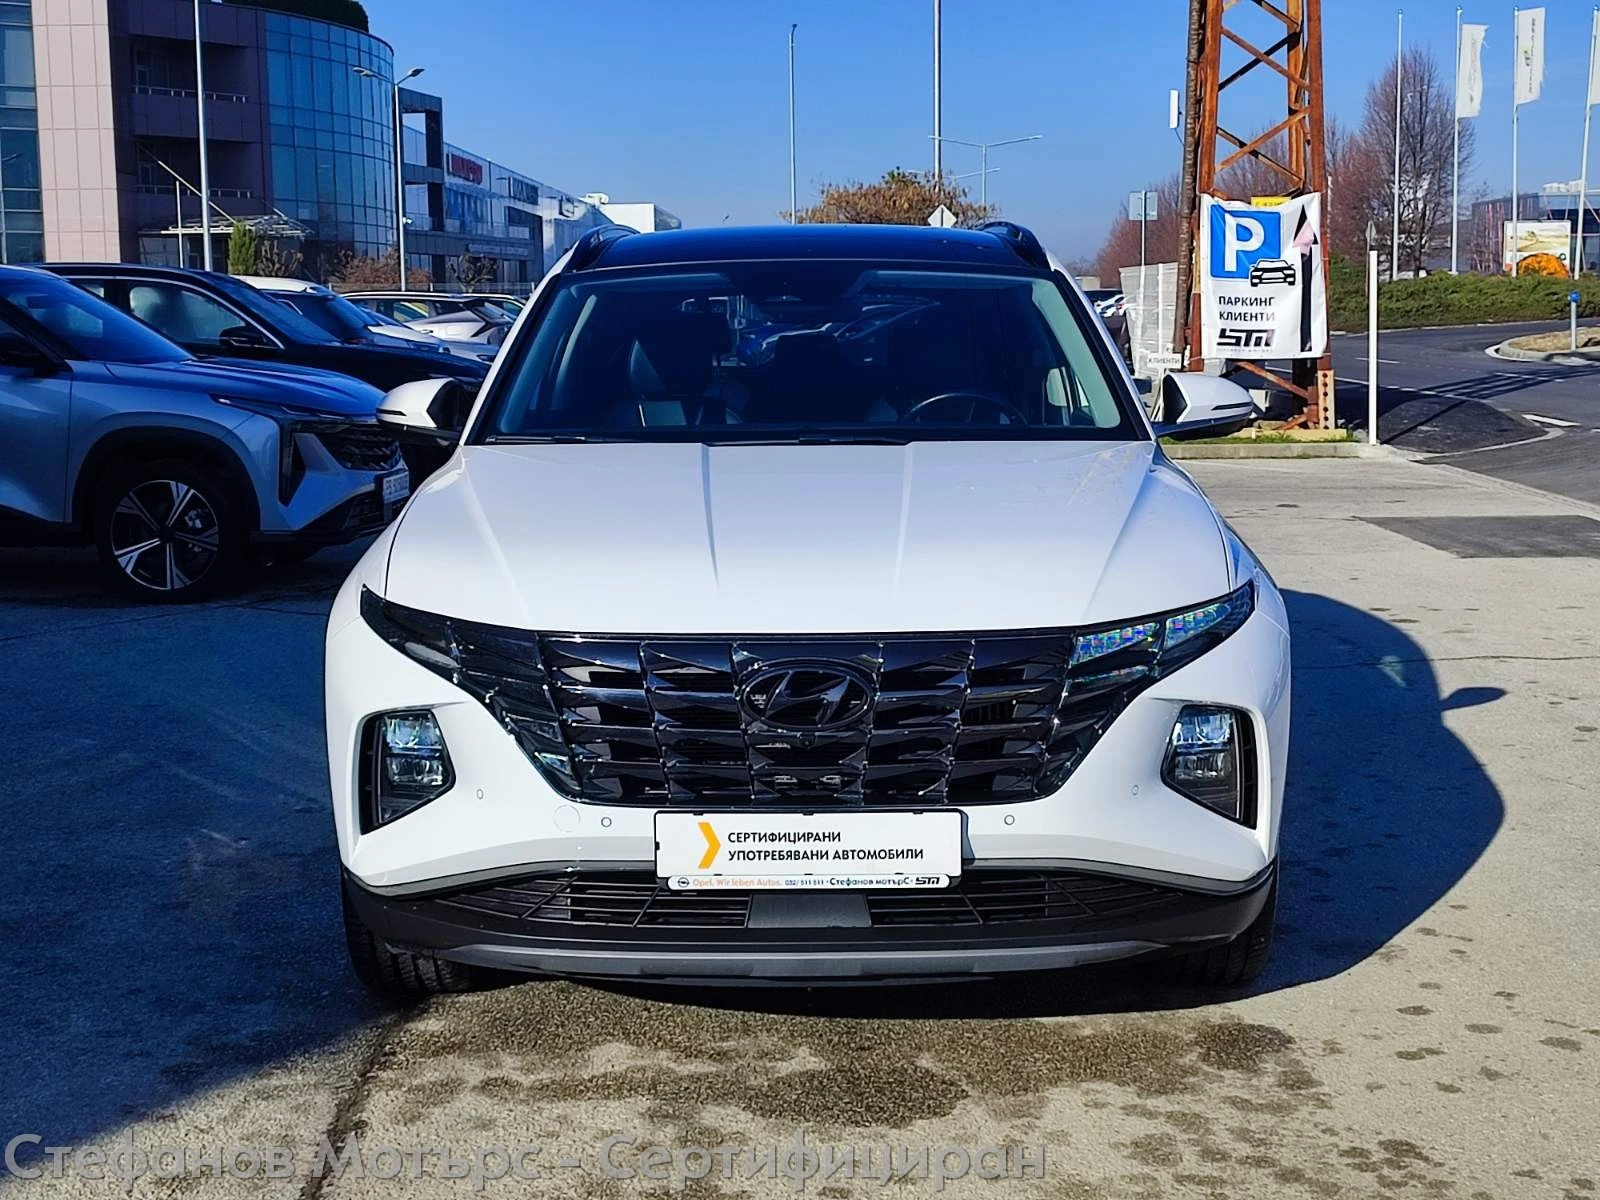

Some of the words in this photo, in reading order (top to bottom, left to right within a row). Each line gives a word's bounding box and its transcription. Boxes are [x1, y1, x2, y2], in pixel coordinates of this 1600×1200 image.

[1224, 212, 1265, 272] P
[1218, 296, 1276, 307] ПАРКИНГ
[1218, 311, 1276, 322] КЛИЕНТИ
[727, 831, 841, 845] СЕРТИФИЦИРАНИ
[727, 849, 829, 862] УПОТРЕБЯВАНИ
[832, 848, 924, 861] АВТОМОБИЛИ
[829, 877, 873, 888] Стефанов
